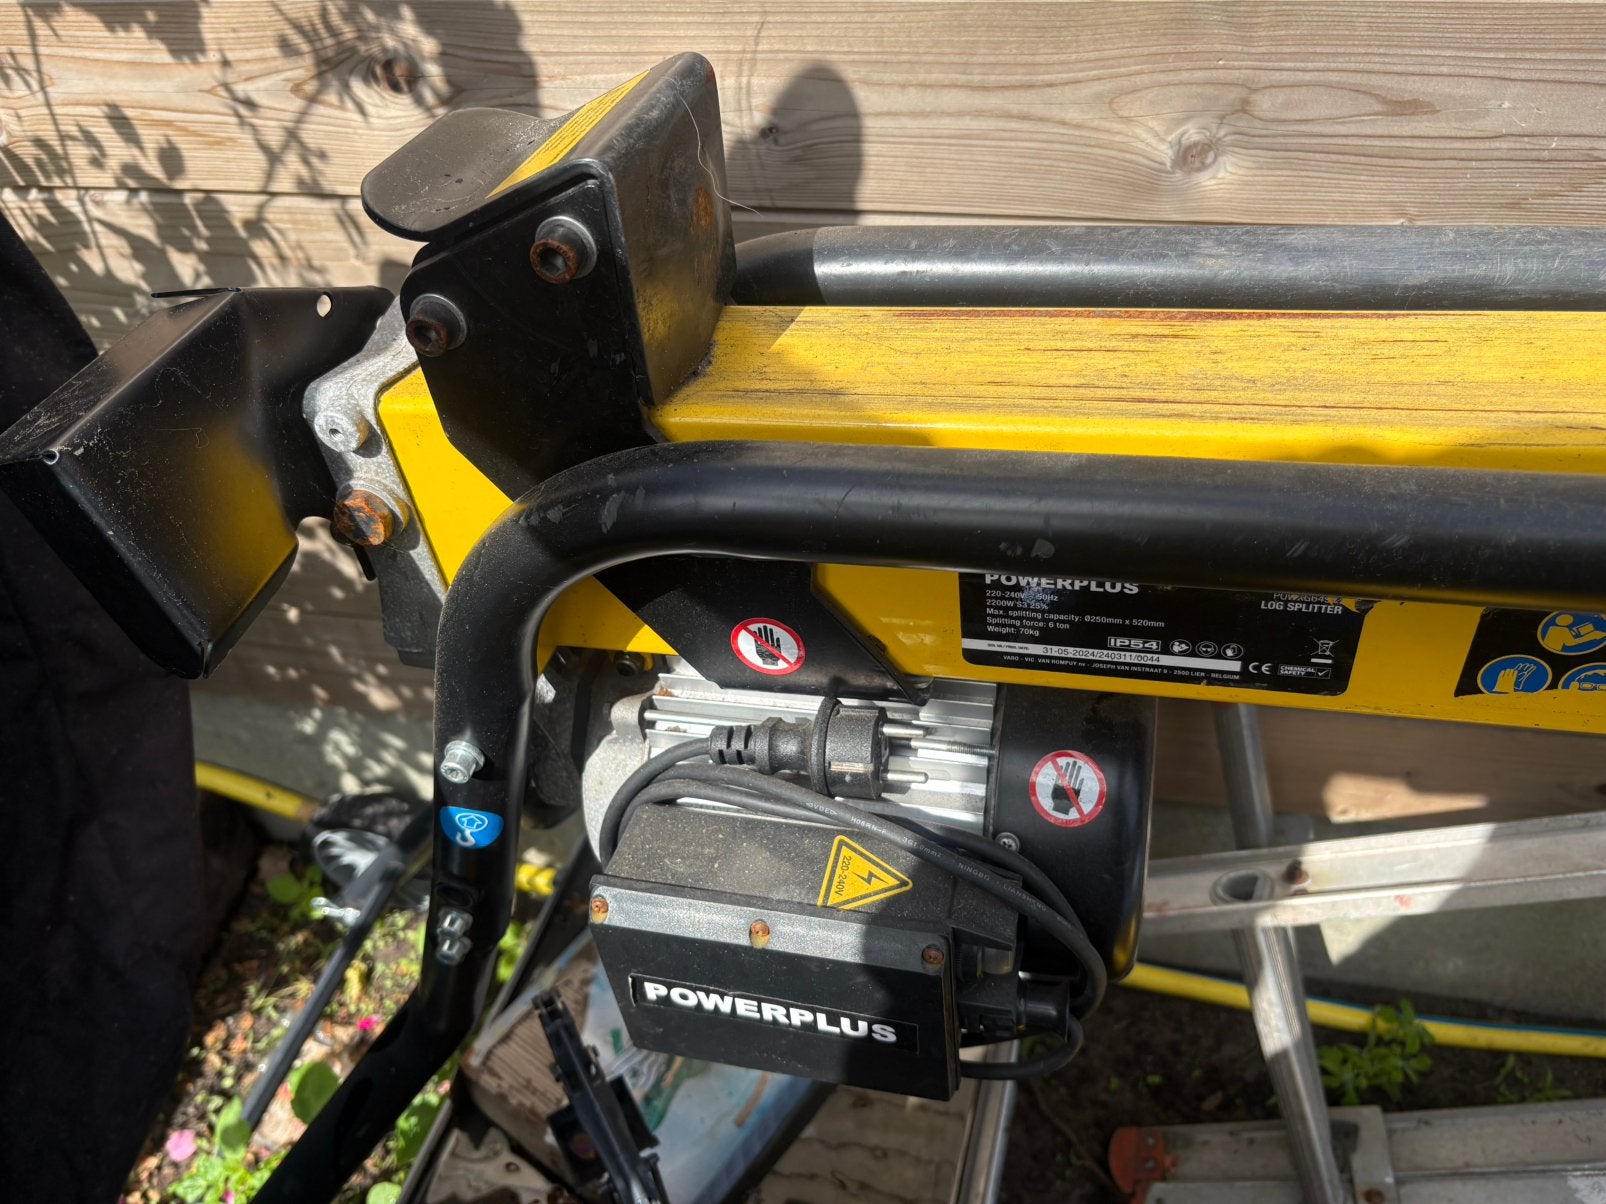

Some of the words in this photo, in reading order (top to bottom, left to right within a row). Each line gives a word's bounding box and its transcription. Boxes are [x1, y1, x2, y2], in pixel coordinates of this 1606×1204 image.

[985, 574, 1139, 594] POWERPLUS
[986, 599, 1014, 607] 2200W
[1030, 602, 1049, 610] 25%
[1261, 600, 1284, 610] LOG
[1287, 602, 1343, 614] SPLITTER
[986, 616, 1021, 627] Splitting
[1023, 619, 1047, 627] force:
[1008, 610, 1042, 620] splitting
[1044, 613, 1082, 622] capacity:
[1132, 618, 1165, 627] 520mm
[986, 625, 1017, 634] Weight:
[1020, 628, 1040, 637] 70kg
[1110, 638, 1159, 650] IP54
[1042, 646, 1161, 663] 31-05-2024/240311/0044
[1280, 665, 1316, 673] CHEMICAL
[1211, 672, 1241, 680] BELGIUM
[834, 855, 852, 897] 220-240V
[643, 981, 898, 1043] POWERPLUS
